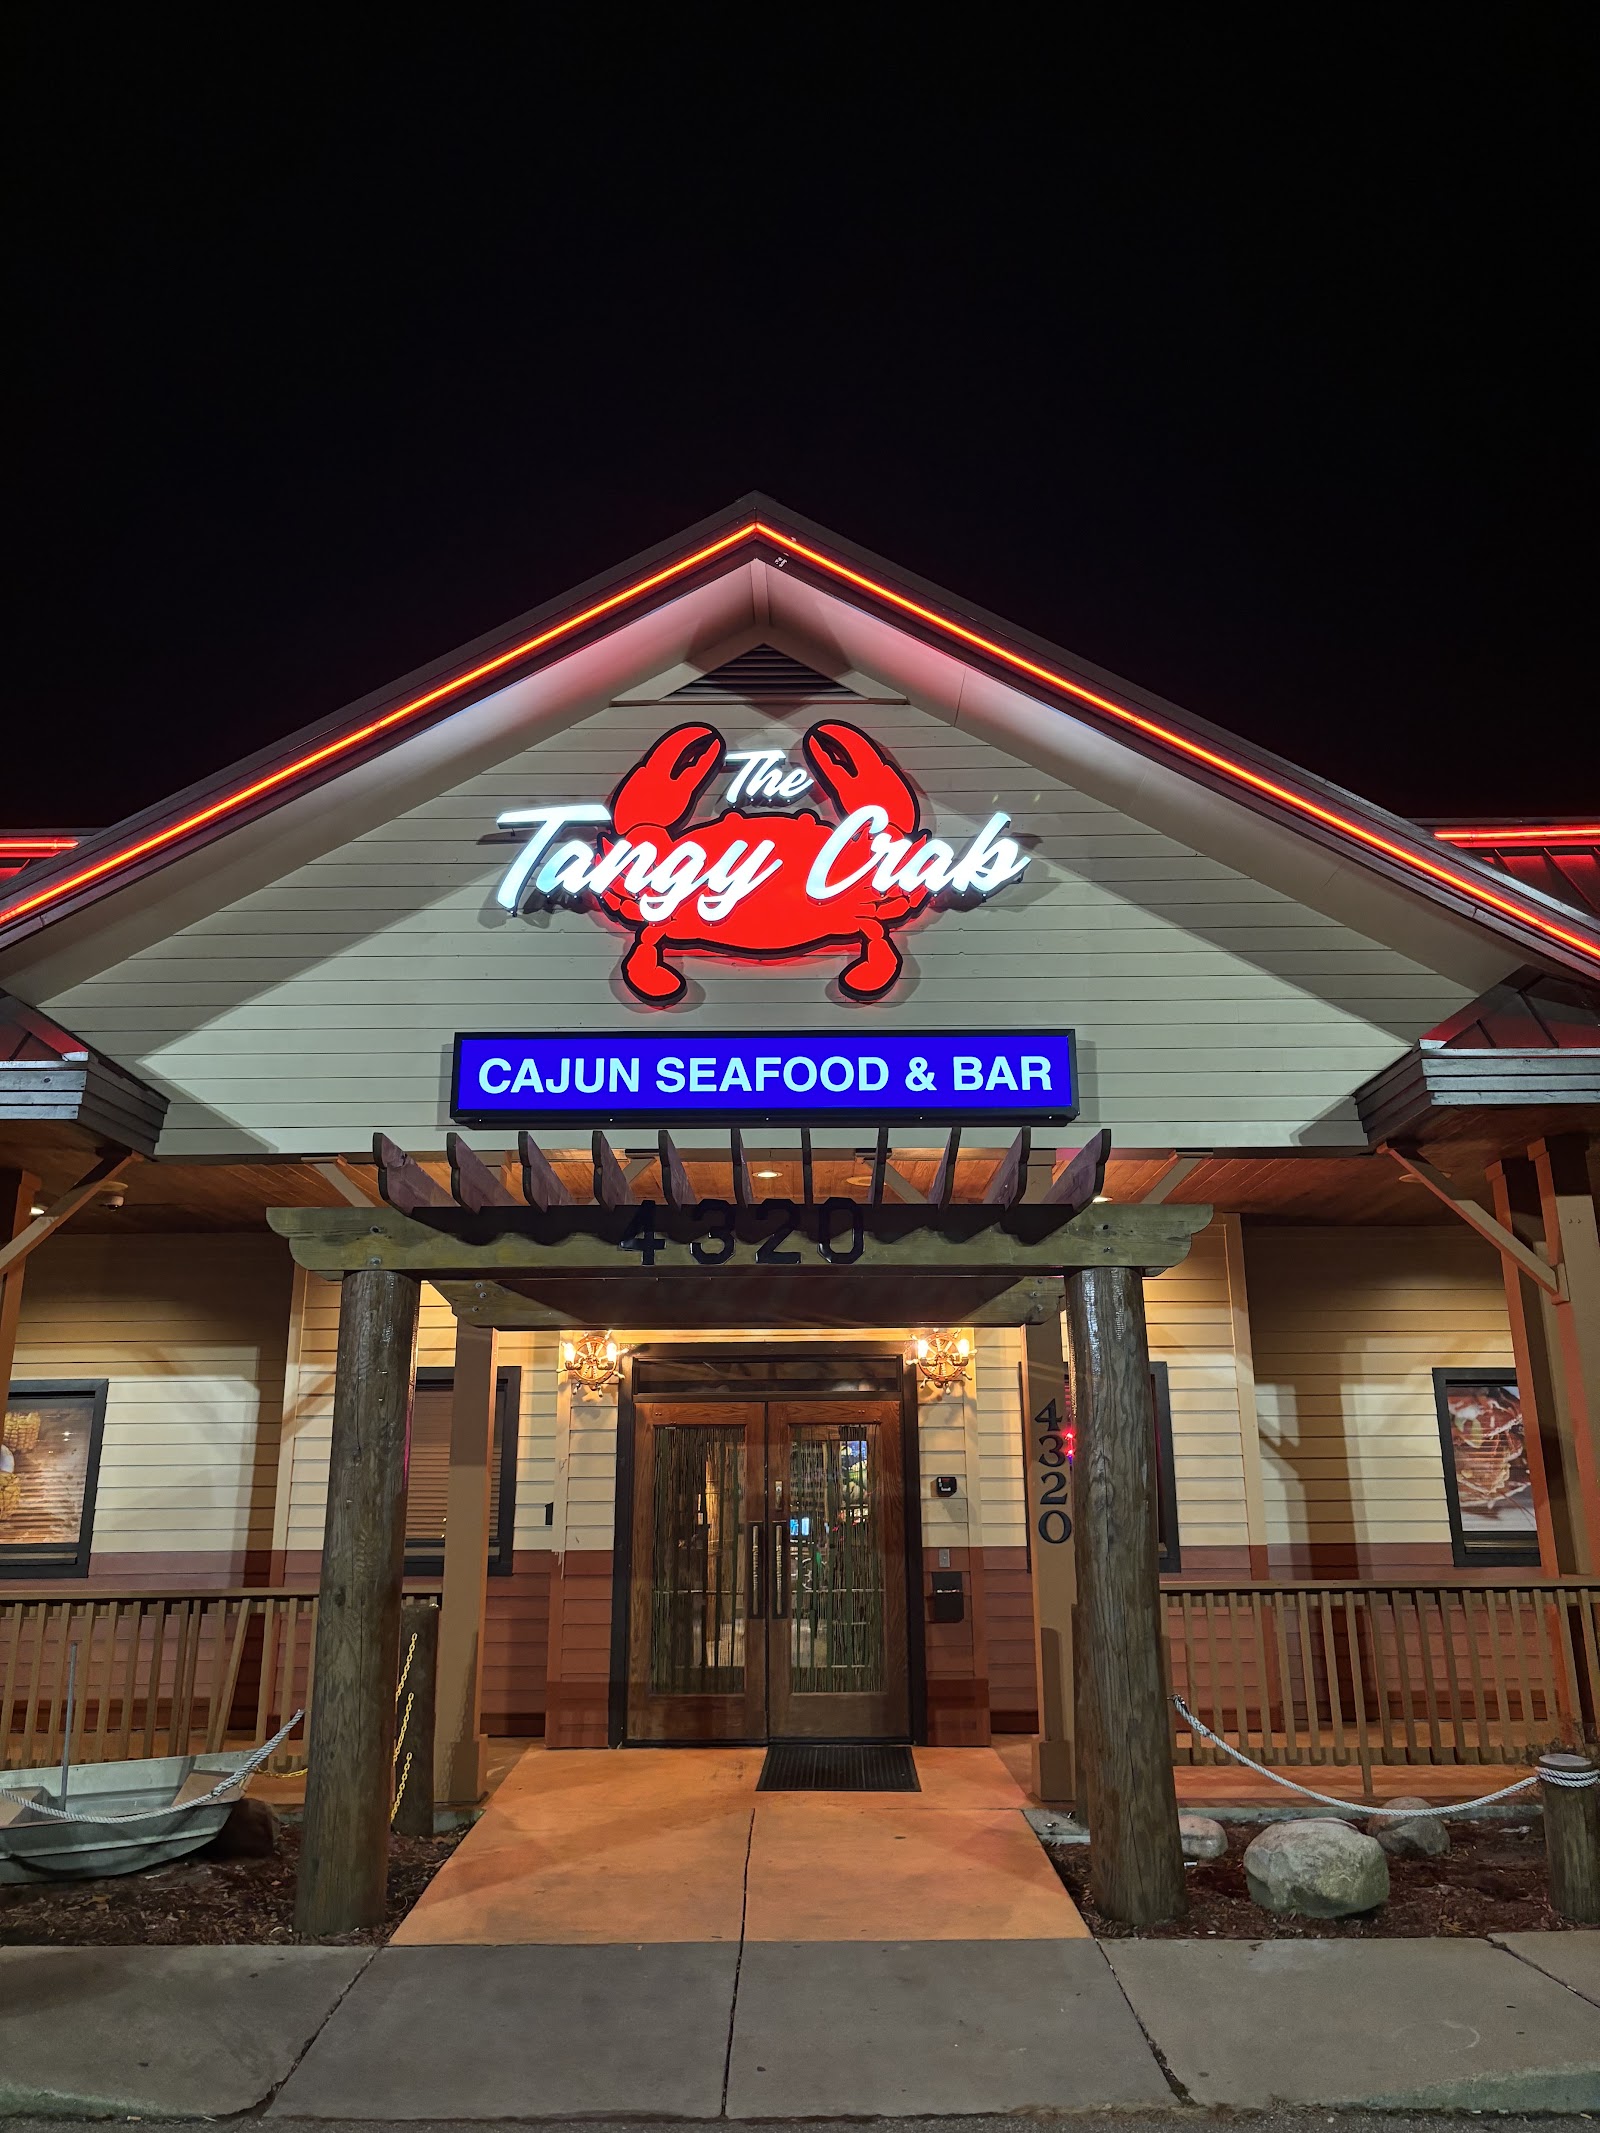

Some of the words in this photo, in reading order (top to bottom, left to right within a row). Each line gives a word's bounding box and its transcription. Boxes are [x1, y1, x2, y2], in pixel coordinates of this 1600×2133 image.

[724, 750, 813, 805] The
[496, 804, 783, 921] Tangy
[805, 804, 1031, 900] Crab
[478, 1057, 640, 1095] CAJUN
[655, 1056, 890, 1094] SEAFOOD
[905, 1056, 937, 1092] &
[952, 1055, 1053, 1092] BAR
[618, 1198, 864, 1266] 4320
[1034, 1398, 1072, 1544] 4320
